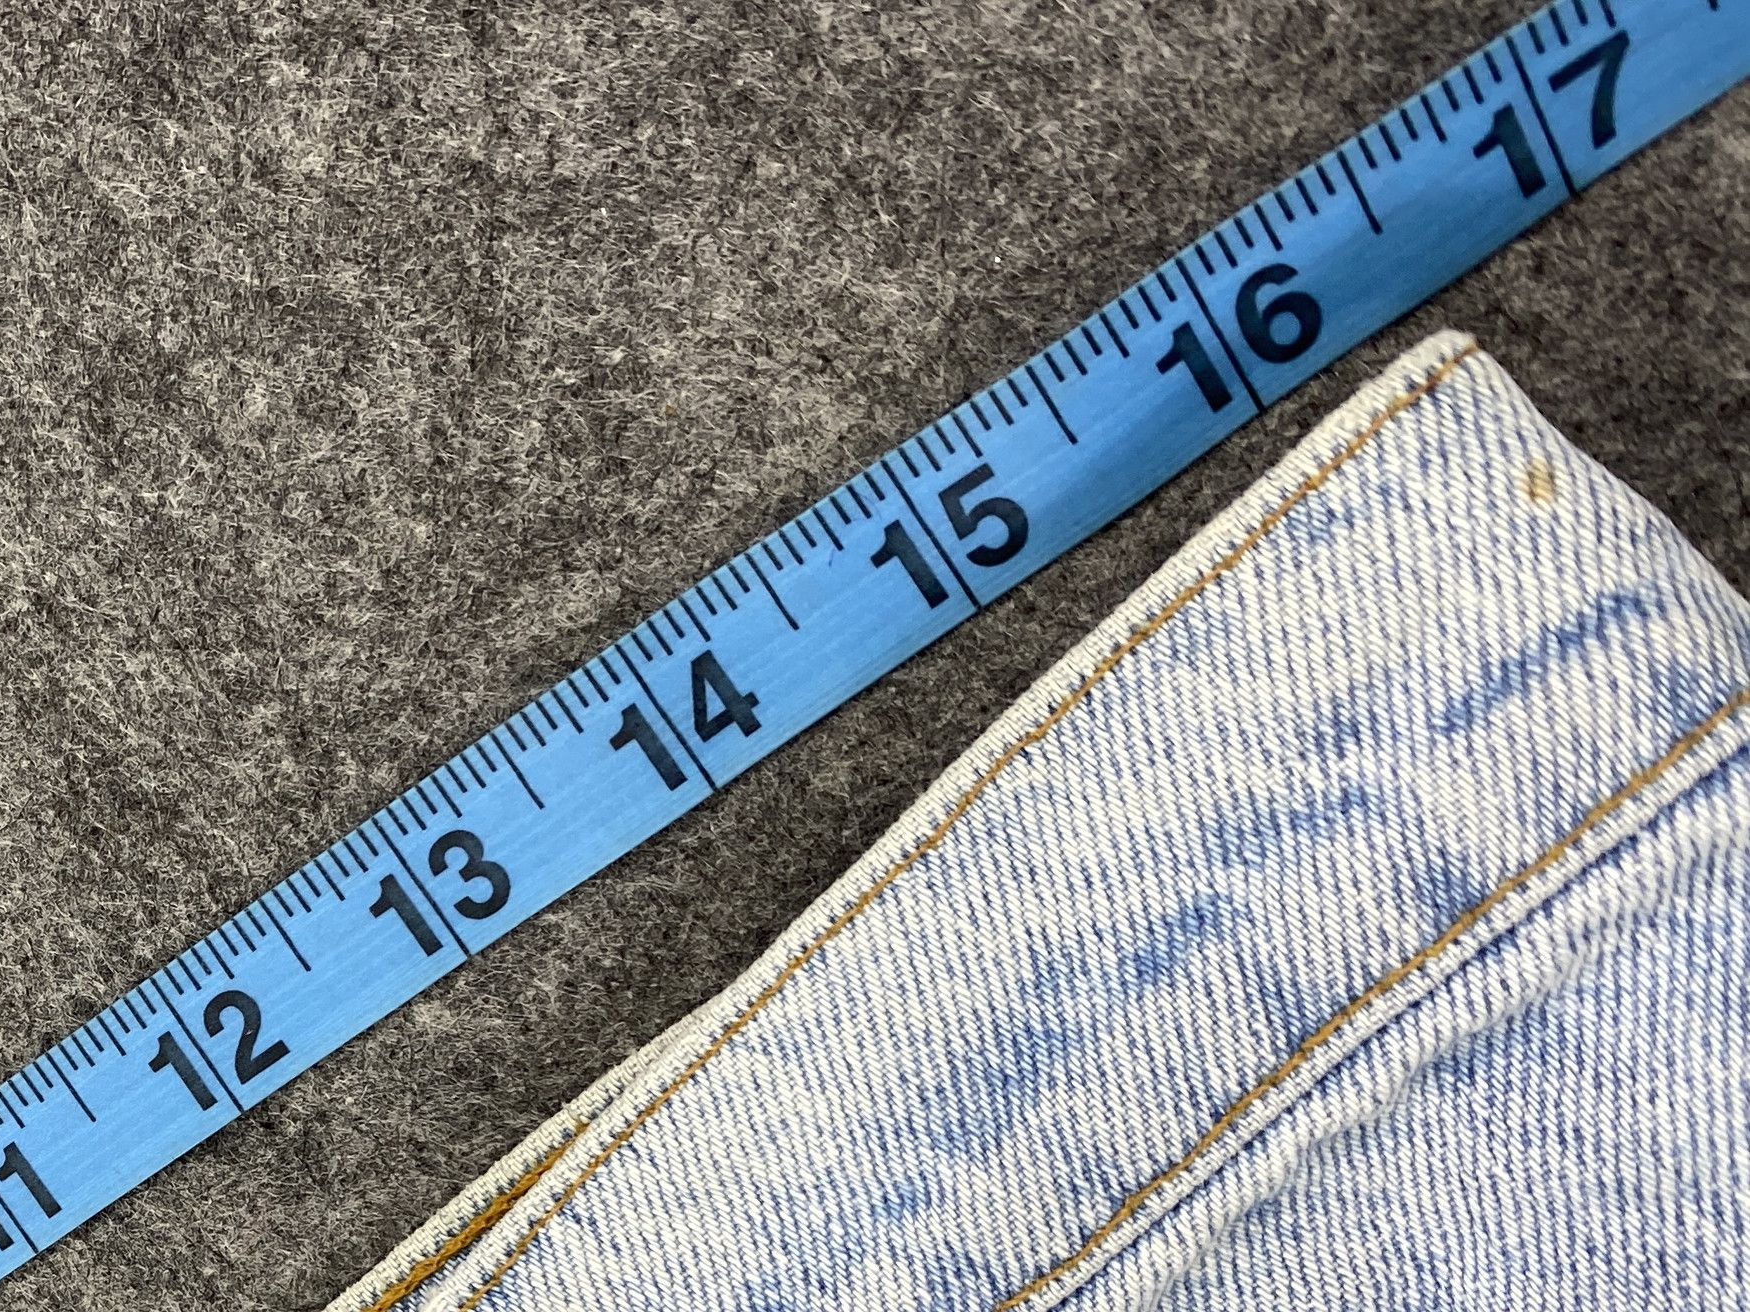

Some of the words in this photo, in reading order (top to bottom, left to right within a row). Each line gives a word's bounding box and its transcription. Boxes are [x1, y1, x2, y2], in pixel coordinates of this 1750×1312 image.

[1472, 29, 1630, 198] 17
[1156, 262, 1322, 413] 16
[870, 463, 1030, 609] 15
[610, 649, 762, 791] 14
[369, 829, 512, 956] 13
[148, 989, 290, 1111] 12
